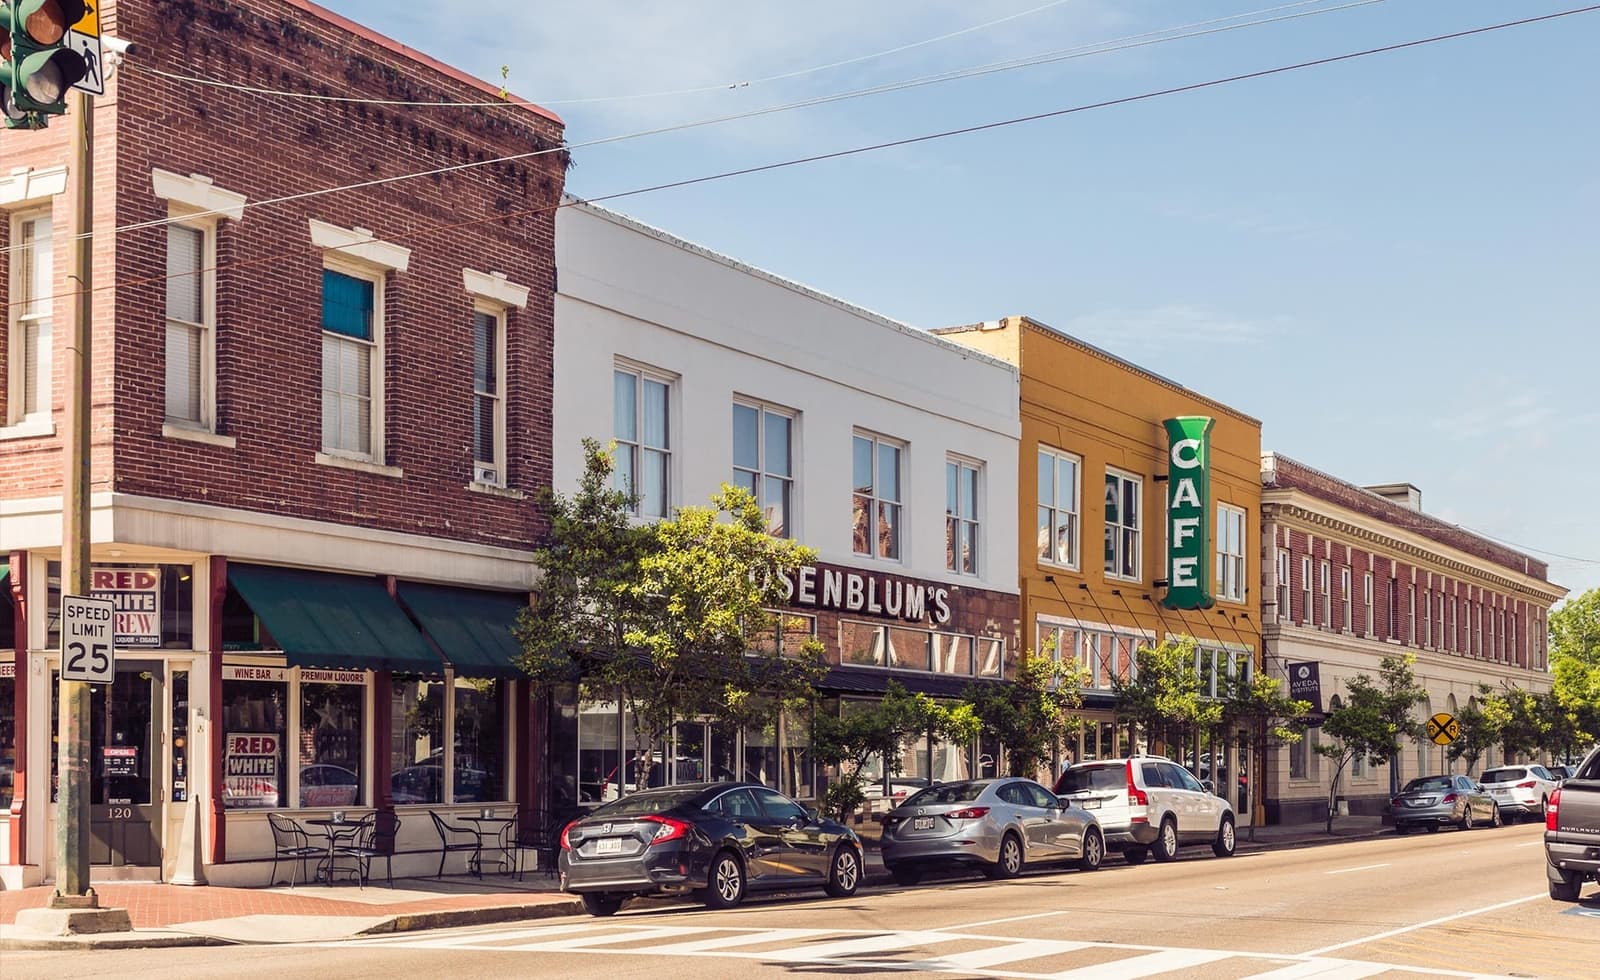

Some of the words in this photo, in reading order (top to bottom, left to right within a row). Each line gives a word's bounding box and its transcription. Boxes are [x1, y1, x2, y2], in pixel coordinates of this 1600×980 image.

[1171, 438, 1202, 588] CAFE
[94, 571, 156, 589] RED
[68, 605, 110, 621] SPEED
[72, 623, 105, 638] LIMIT
[114, 613, 155, 634] REW
[67, 642, 109, 674] 25
[234, 668, 255, 679] WINE
[256, 669, 271, 680] BAR
[301, 671, 333, 682] PREMIUM
[334, 673, 364, 683] LIQUORS
[1292, 680, 1319, 688] AVEDA
[1449, 724, 1457, 734] R
[235, 737, 276, 754] RED
[230, 758, 274, 774] WHITE
[109, 807, 131, 819] 120
